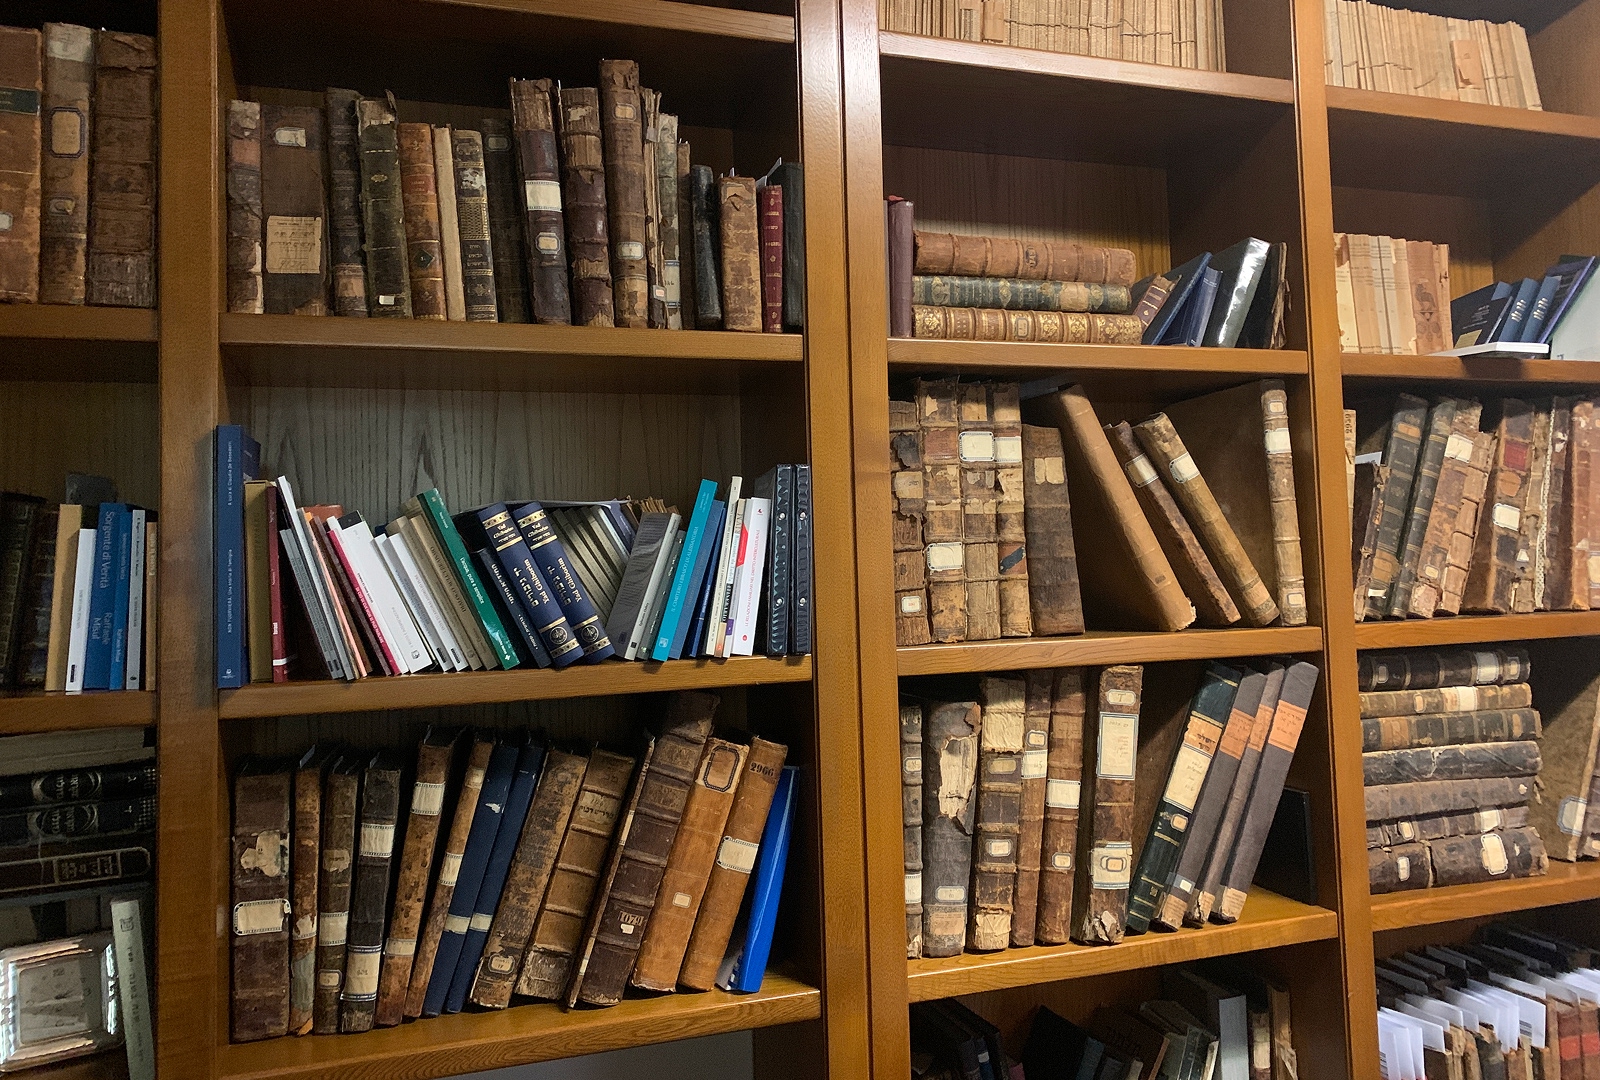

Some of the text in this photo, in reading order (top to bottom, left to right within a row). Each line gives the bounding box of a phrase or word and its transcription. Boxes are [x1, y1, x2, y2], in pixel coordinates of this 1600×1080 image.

[98, 510, 114, 588] Sorgente di Verità
[752, 529, 760, 560] INTERCULTURALE
[460, 556, 470, 573] L'acqua,
[472, 585, 484, 604] semplice
[524, 558, 542, 591] Ghiborim
[557, 557, 582, 603] Yad Ghiborim
[672, 583, 682, 607] CIMITERO
[679, 563, 687, 583] EBRAICO
[687, 526, 699, 556] ALESSANDRIA
[450, 588, 466, 612] DIALOGO
[513, 566, 539, 607] יד גיבורים
[540, 590, 550, 604] Yad
[546, 565, 571, 606] יד גיבורים
[91, 617, 101, 640] Misul
[101, 612, 112, 645] Raffaele
[374, 628, 384, 643] PARLARE
[750, 761, 775, 777] 2966
